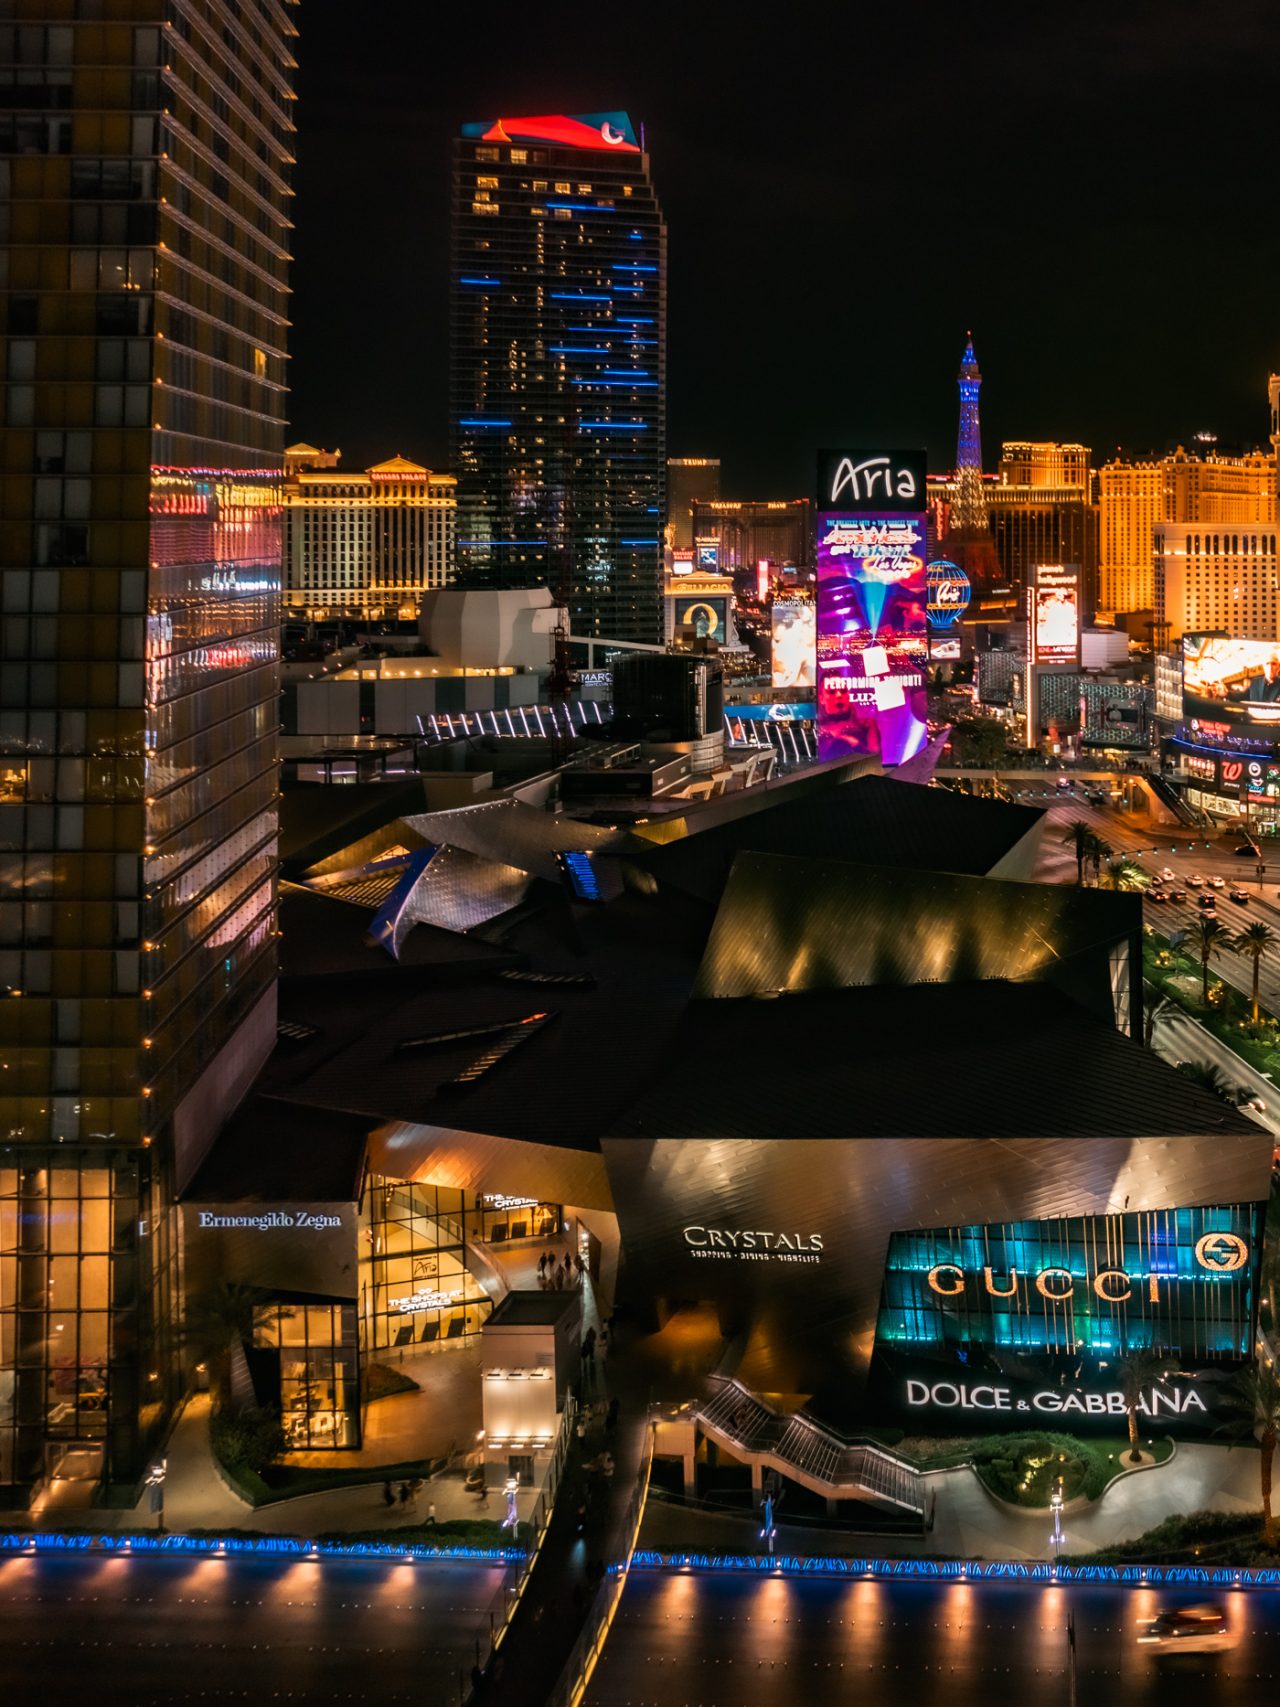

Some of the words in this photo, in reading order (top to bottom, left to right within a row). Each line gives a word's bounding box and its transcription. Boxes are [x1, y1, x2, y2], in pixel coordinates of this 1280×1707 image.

[831, 457, 917, 502] Aria
[484, 1193, 506, 1204] THE
[198, 1211, 294, 1231] Ermenegildo
[295, 1211, 342, 1231] Zegna
[682, 1226, 824, 1251] CRYSTALS
[690, 1249, 732, 1259] SHOPPING
[740, 1252, 770, 1261] DINING
[927, 1263, 1161, 1303] GUCCI
[389, 1297, 411, 1307] THE
[411, 1292, 444, 1303] SHOPS
[399, 1299, 452, 1312] CRYSTALS
[905, 1379, 1013, 1411] DOLCE
[1016, 1399, 1031, 1411] &
[1032, 1386, 1208, 1416] GABBANA
